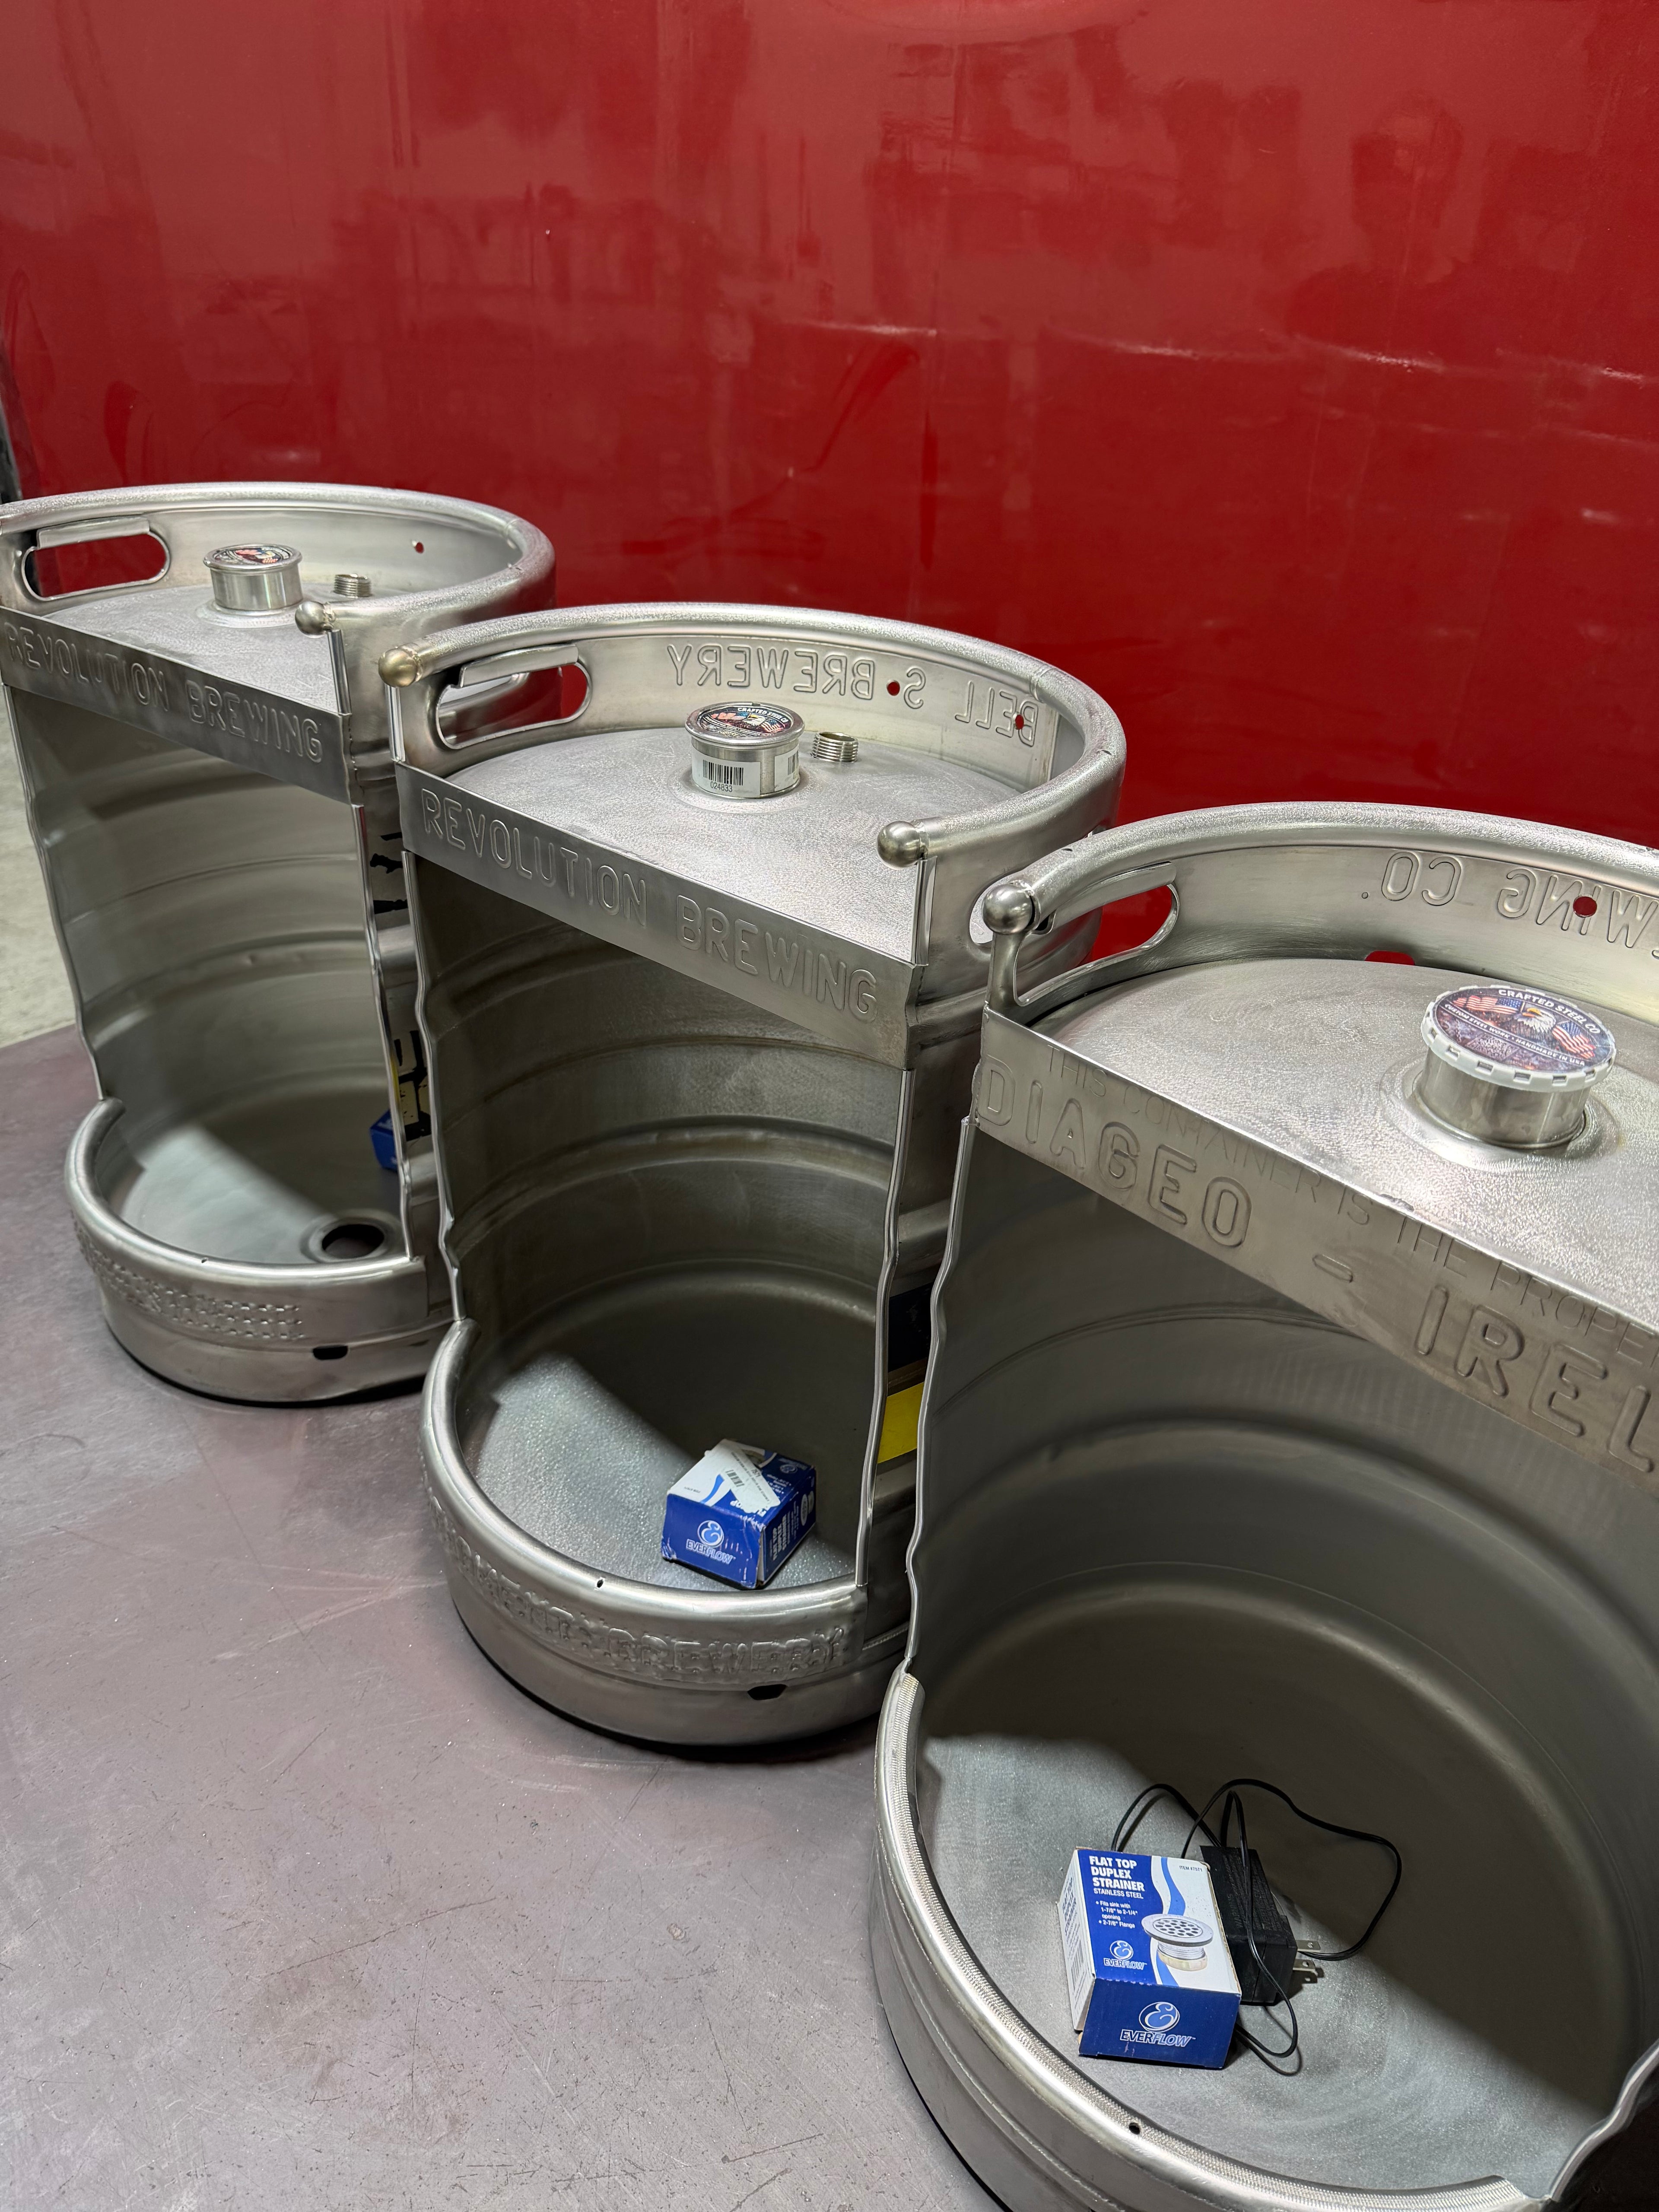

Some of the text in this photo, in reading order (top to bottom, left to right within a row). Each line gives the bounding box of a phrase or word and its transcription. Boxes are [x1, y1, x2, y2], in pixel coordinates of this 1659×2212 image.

[4, 621, 322, 764] REVOLUTION BREWING
[710, 781, 733, 793] 024833
[421, 787, 880, 1023] REVOLUTION BREWING
[1498, 989, 1601, 1034] CRAFTED STEEL CO
[1445, 1004, 1470, 1021] CUSTOM
[1470, 1017, 1488, 1029] STEEL
[1489, 1027, 1510, 1039] WORK
[1516, 1038, 1558, 1057] HANDMADE
[1569, 1058, 1586, 1067] USA
[1048, 1044, 1107, 1097] THIS
[977, 1054, 1252, 1248] DIAGEO
[686, 1538, 734, 1565] EVERFLOW
[1089, 1856, 1137, 1869] FLAT TOP
[1090, 1866, 1132, 1879] DUPLEX
[1092, 1877, 1145, 1892] STRAINER
[1093, 1888, 1125, 1897] STAINLESS
[1103, 1958, 1145, 1970] EVERFLOW
[1119, 2029, 1192, 2047] EVERFLOW
